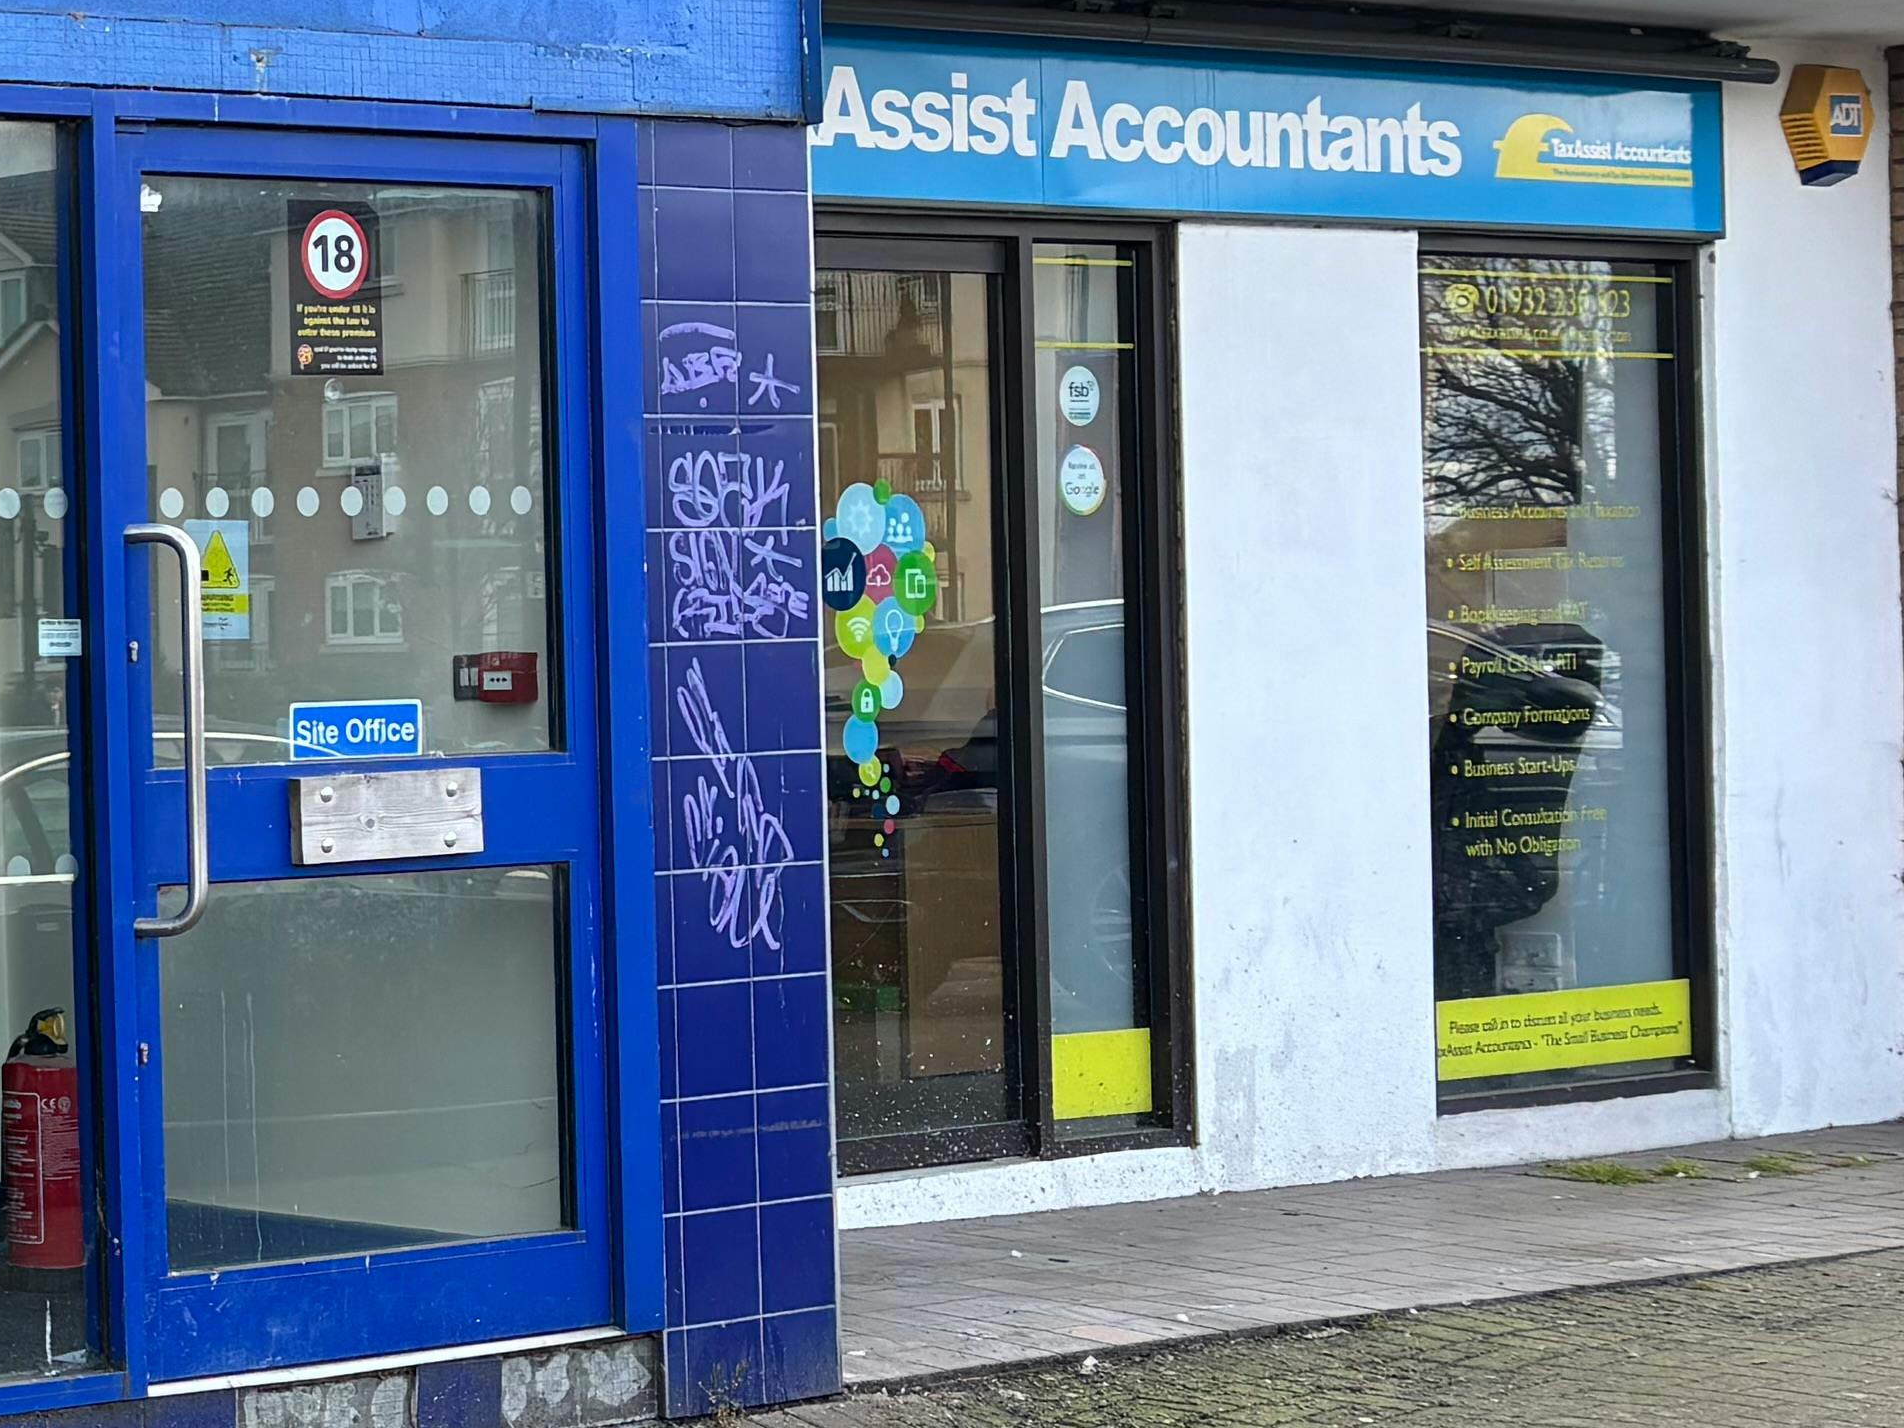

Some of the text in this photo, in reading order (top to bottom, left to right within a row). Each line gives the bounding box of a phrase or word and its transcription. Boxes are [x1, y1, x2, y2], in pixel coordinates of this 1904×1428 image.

[808, 64, 1463, 178] Assist Accountants
[1829, 102, 1863, 127] ADT
[1550, 137, 1692, 164] TaxAssist Accountants
[311, 236, 356, 273] 18
[1485, 285, 1547, 316] 01932
[1068, 382, 1089, 398] fsb
[1065, 481, 1100, 497] Google
[1458, 552, 1481, 570] Self
[1463, 705, 1591, 728] Company Formations
[296, 717, 415, 745] Site Office
[1464, 755, 1576, 778] Business Start-Ups
[1465, 810, 1498, 829] Initial
[1501, 808, 1577, 827] Consultation
[1465, 835, 1582, 858] with No Obligation
[1449, 1020, 1480, 1035] Please
